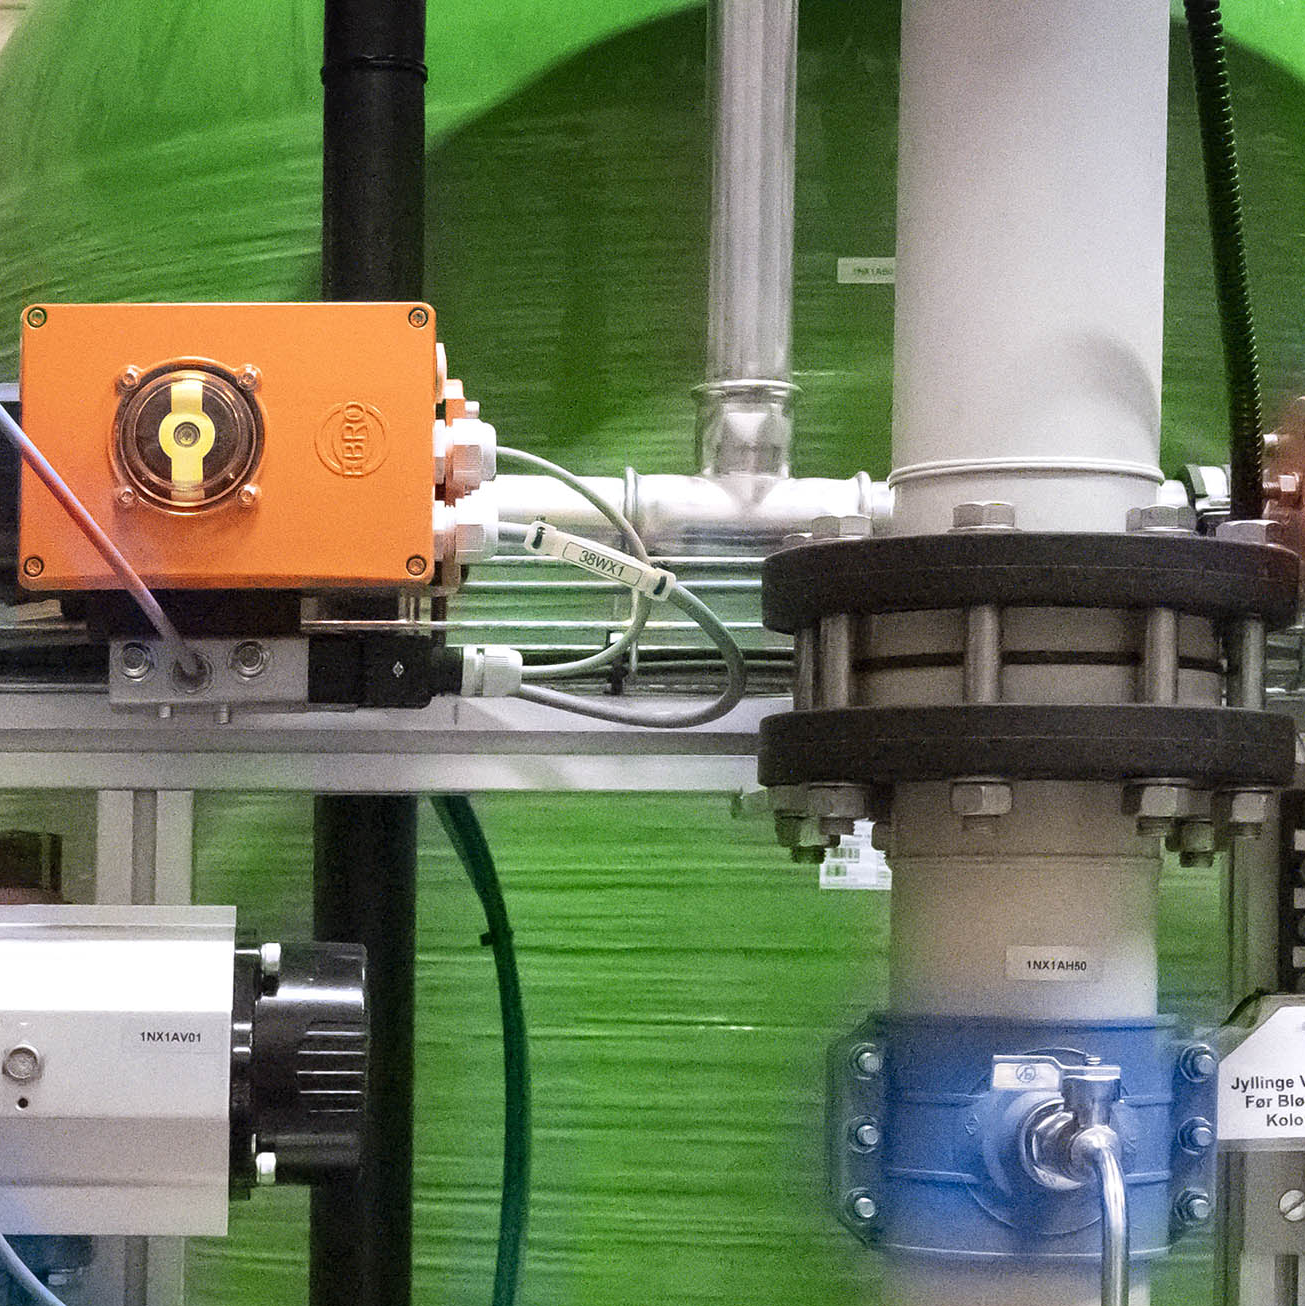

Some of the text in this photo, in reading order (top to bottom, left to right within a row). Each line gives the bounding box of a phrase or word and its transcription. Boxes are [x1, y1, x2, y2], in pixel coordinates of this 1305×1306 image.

[579, 550, 625, 577] 38WX1
[1026, 960, 1088, 971] 1NX1AH50
[140, 1031, 202, 1043] 1NX1AV01
[1230, 1076, 1295, 1093] Jyllinge
[1245, 1094, 1273, 1109] Før
